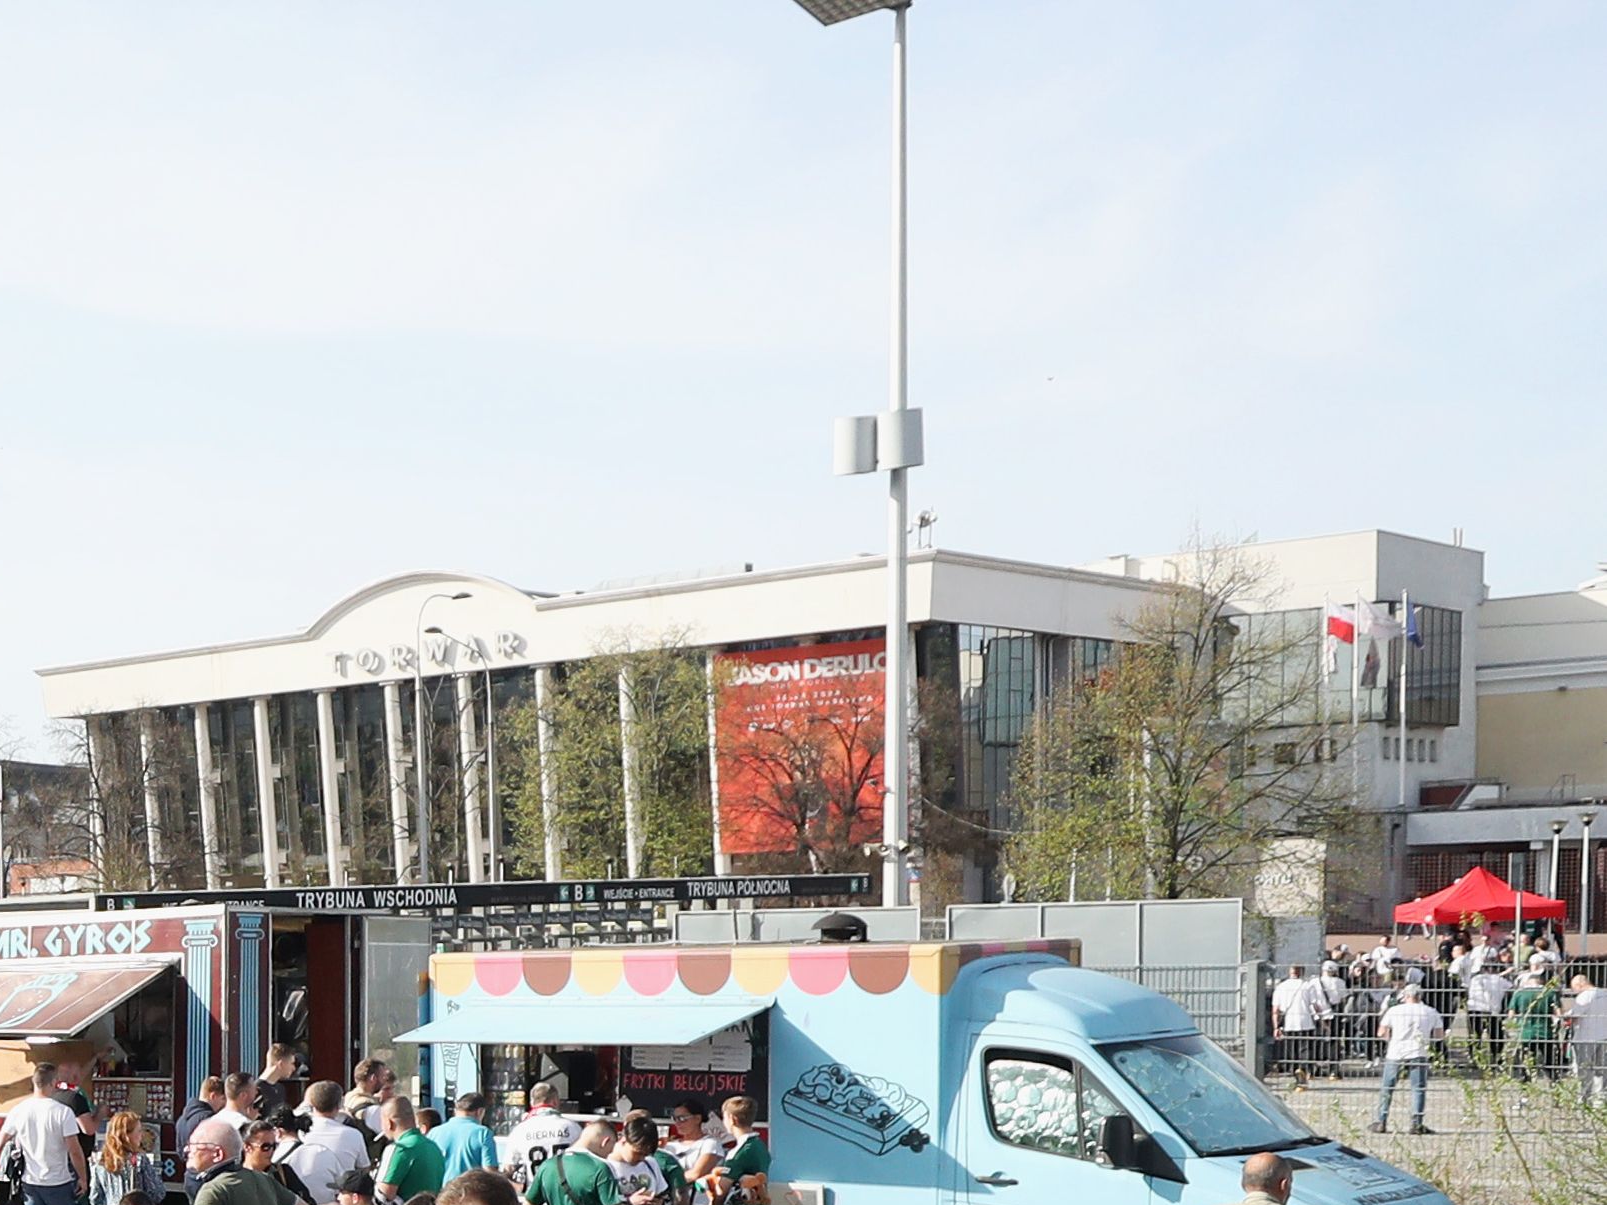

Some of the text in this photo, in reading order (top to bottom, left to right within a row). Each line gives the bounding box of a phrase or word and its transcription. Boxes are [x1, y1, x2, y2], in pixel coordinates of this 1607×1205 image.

[333, 631, 528, 679] TORWAR
[106, 898, 115, 911] B
[296, 890, 365, 909] TRYBUNA
[373, 887, 458, 908] WSCHODNIA
[574, 885, 583, 901] B
[638, 886, 675, 899] ENTRANCE
[687, 880, 734, 897] TRYBUNA
[736, 877, 792, 896] PÓŁNOCNA
[43, 919, 153, 957] GYROS
[623, 1073, 748, 1096] FRYTKI BELGIJSKIE
